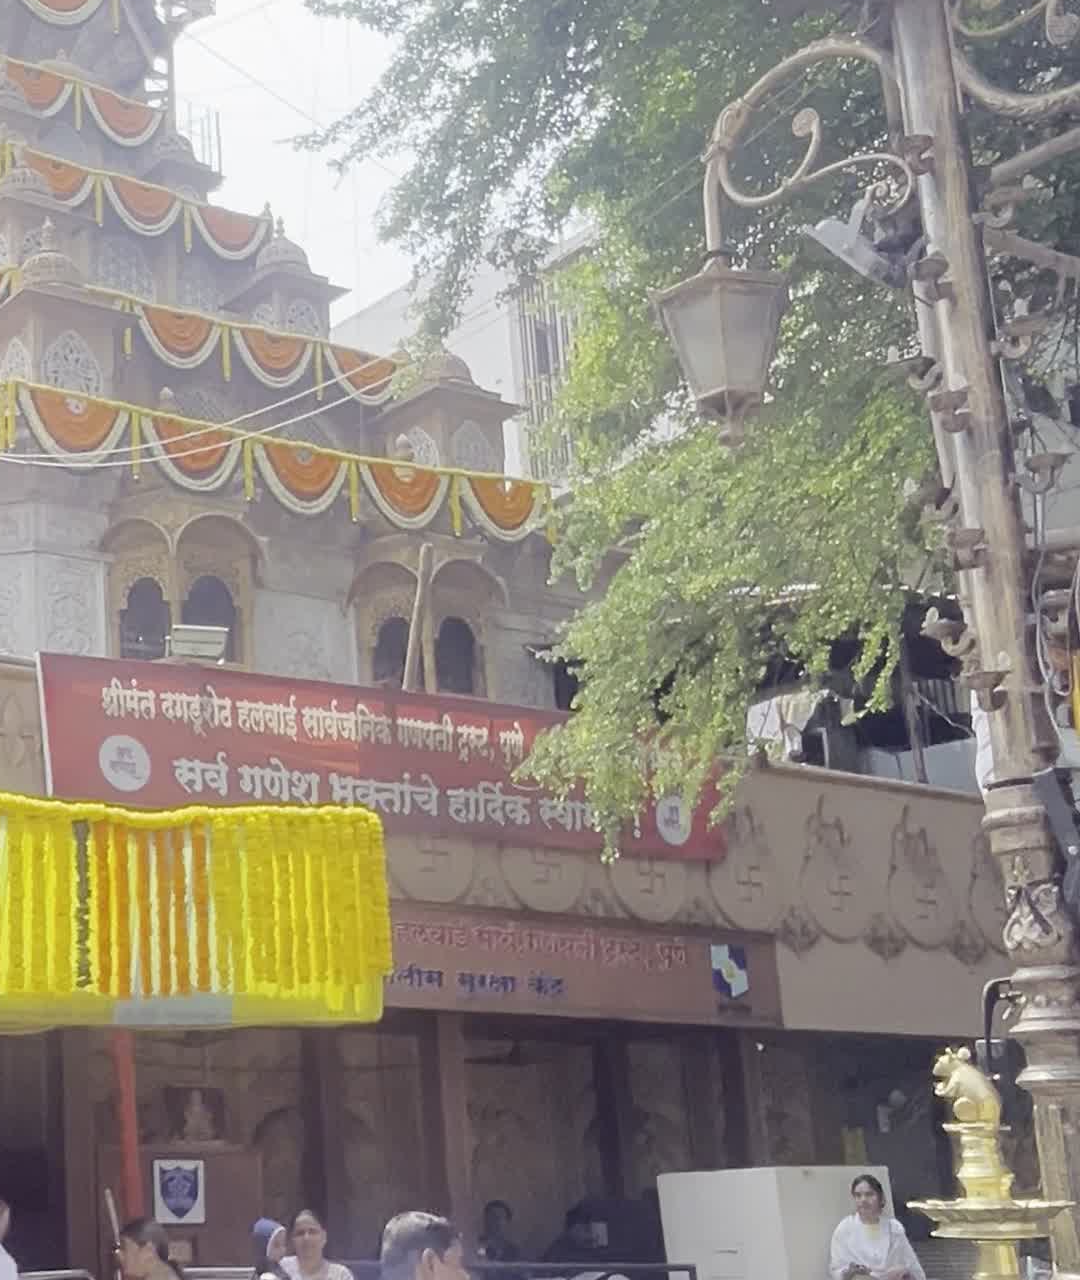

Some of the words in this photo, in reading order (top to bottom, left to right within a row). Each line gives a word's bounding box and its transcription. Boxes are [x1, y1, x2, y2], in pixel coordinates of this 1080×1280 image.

[102, 677, 156, 720] श्रीमंत
[159, 684, 232, 737] दगडूशेठ
[236, 694, 297, 742] हलवाई
[301, 699, 392, 745] सार्वजनिक
[396, 713, 454, 752] गणपती
[172, 751, 229, 797] सर्व
[237, 757, 320, 805] गणेश
[328, 772, 439, 817] भक्तांचे
[446, 780, 531, 826] हार्दिक
